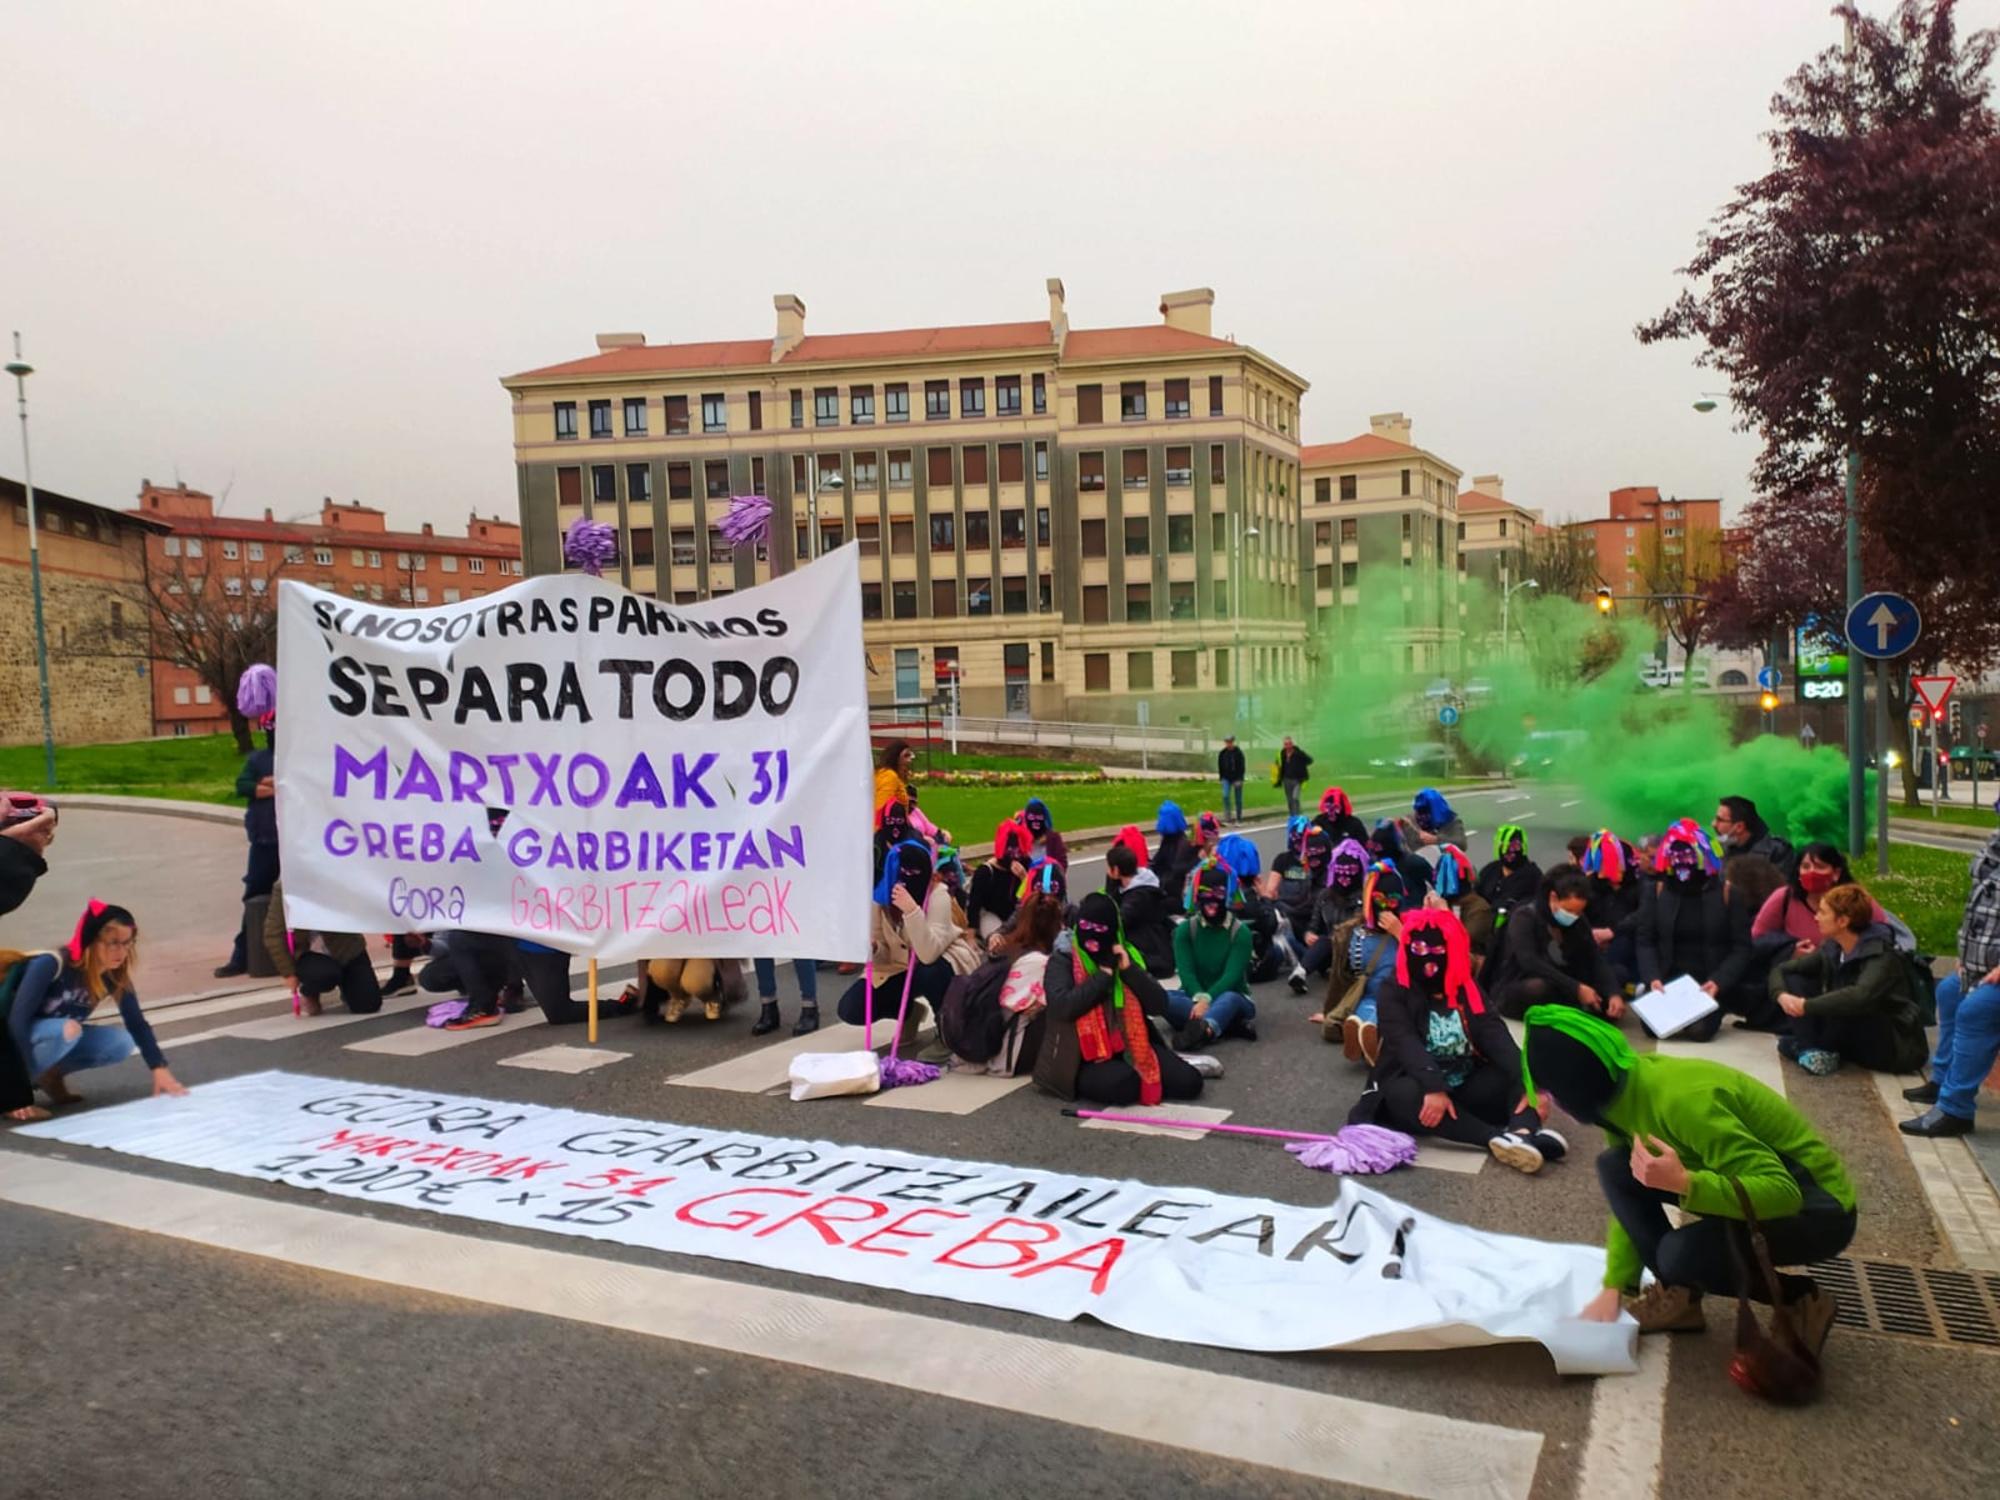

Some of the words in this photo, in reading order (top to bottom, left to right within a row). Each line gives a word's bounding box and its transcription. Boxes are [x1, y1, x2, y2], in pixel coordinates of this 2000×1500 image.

[350, 598, 579, 643] NOSOTRAS
[598, 656, 799, 722] TODO
[333, 745, 719, 809] MARTXOAK
[748, 749, 788, 805] 31
[324, 818, 481, 863] GREBA
[507, 825, 806, 872] GARBIKETAN
[300, 1093, 526, 1139] GORA
[297, 1129, 569, 1179] MARTXOAK
[563, 1169, 677, 1197] 31
[538, 1196, 655, 1224] 15
[675, 1188, 1127, 1296] GREBA
